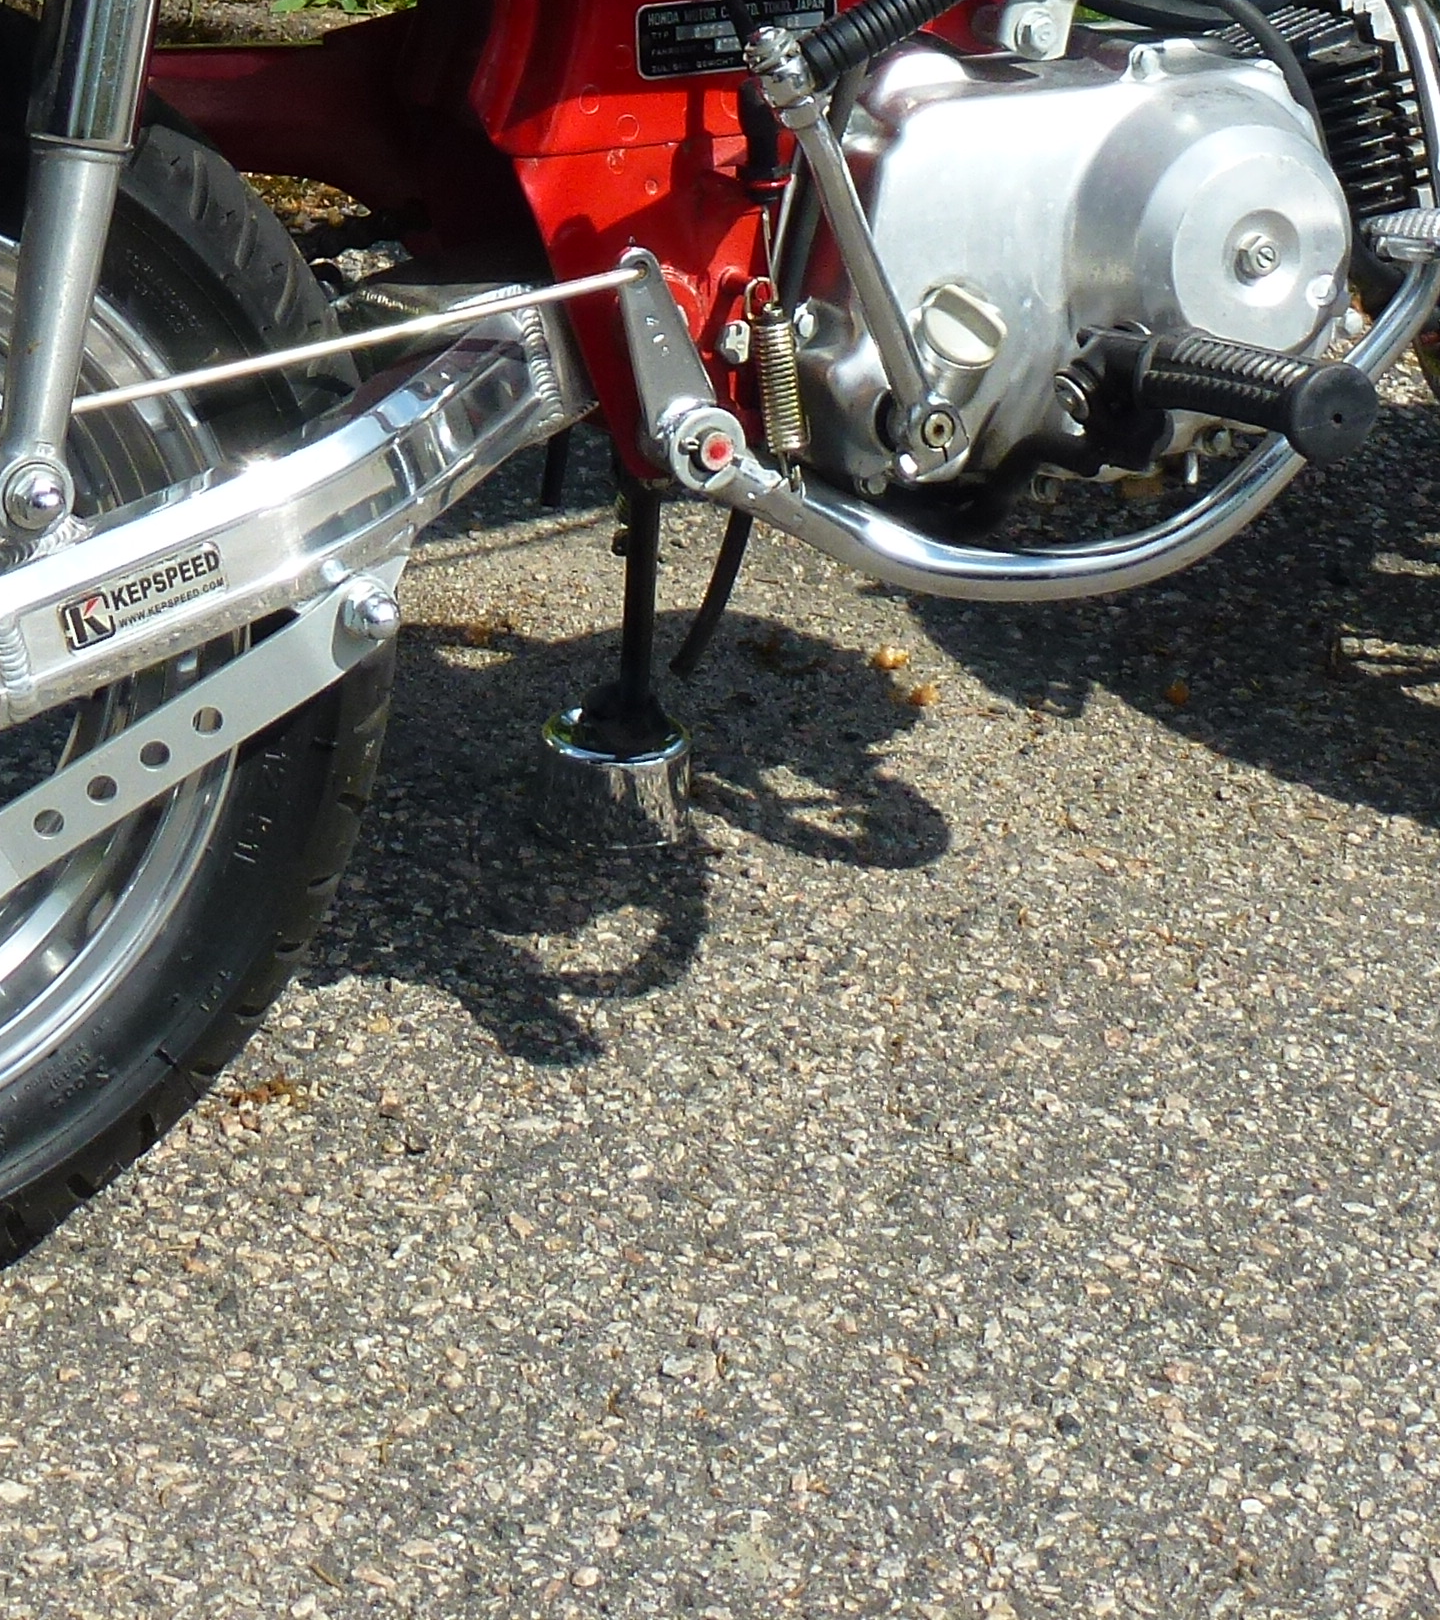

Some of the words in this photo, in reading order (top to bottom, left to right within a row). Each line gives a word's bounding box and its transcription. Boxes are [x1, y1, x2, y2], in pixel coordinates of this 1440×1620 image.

[648, 11, 680, 26] HONDA
[684, 7, 716, 22] MOTOR
[110, 550, 220, 611] KEPSPEED
[118, 577, 224, 628] WWW.KEPSPEED.COM
